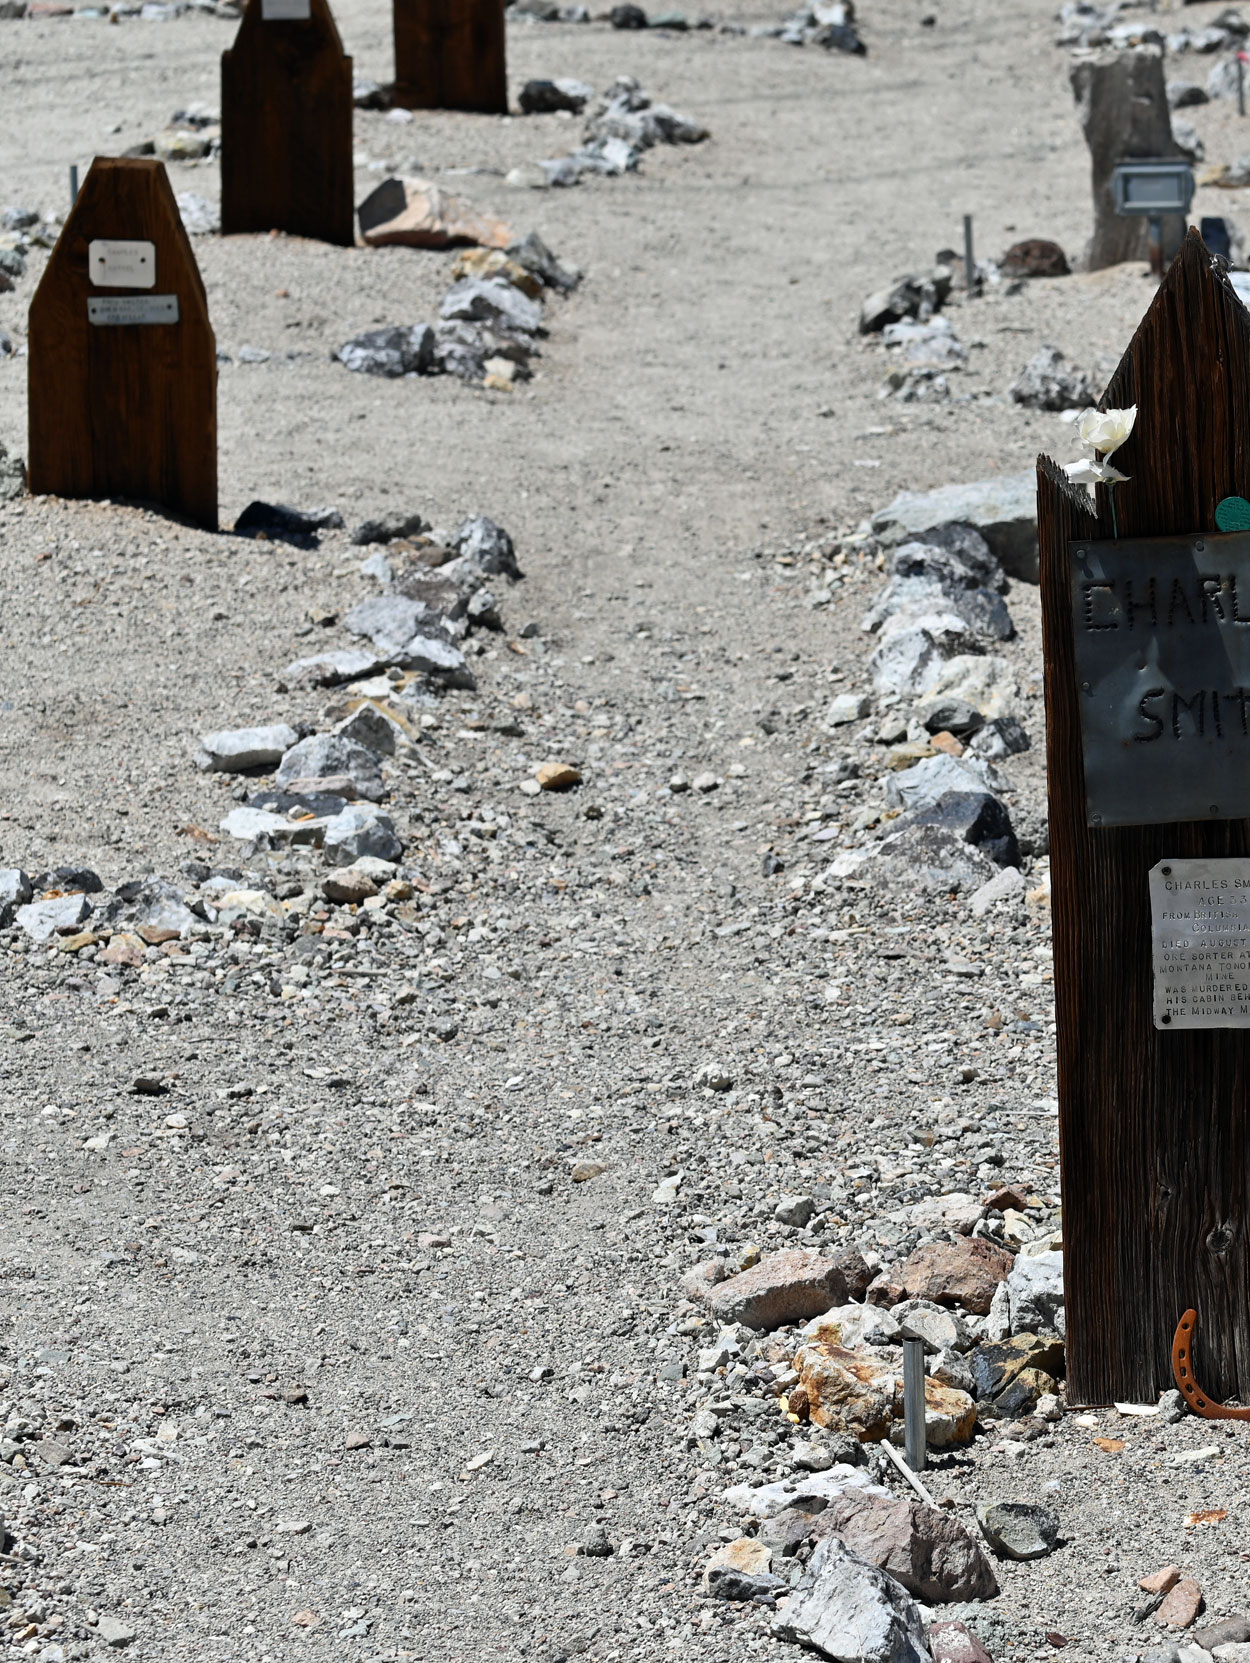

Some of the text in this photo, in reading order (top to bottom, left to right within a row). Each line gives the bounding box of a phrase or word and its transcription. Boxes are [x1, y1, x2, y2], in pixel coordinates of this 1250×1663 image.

[1164, 879, 1228, 891] CHARLES
[1198, 895, 1225, 906] AGE
[1161, 910, 1239, 921] FROM BRITISH
[1192, 922, 1250, 933] COLUMBIA
[1161, 939, 1190, 950] DIED
[1200, 938, 1247, 949] AUGUST
[1163, 952, 1187, 961] ORE
[1191, 951, 1234, 961] SORTER
[1159, 963, 1213, 974] MONTANA
[1205, 971, 1235, 982] MINE
[1164, 985, 1187, 994] WAS
[1191, 983, 1248, 993] MURDERED
[1165, 996, 1187, 1005] HIS
[1192, 994, 1225, 1004] CABIN
[1165, 1007, 1187, 1016] THE
[1191, 1006, 1234, 1016] MIDWAY
